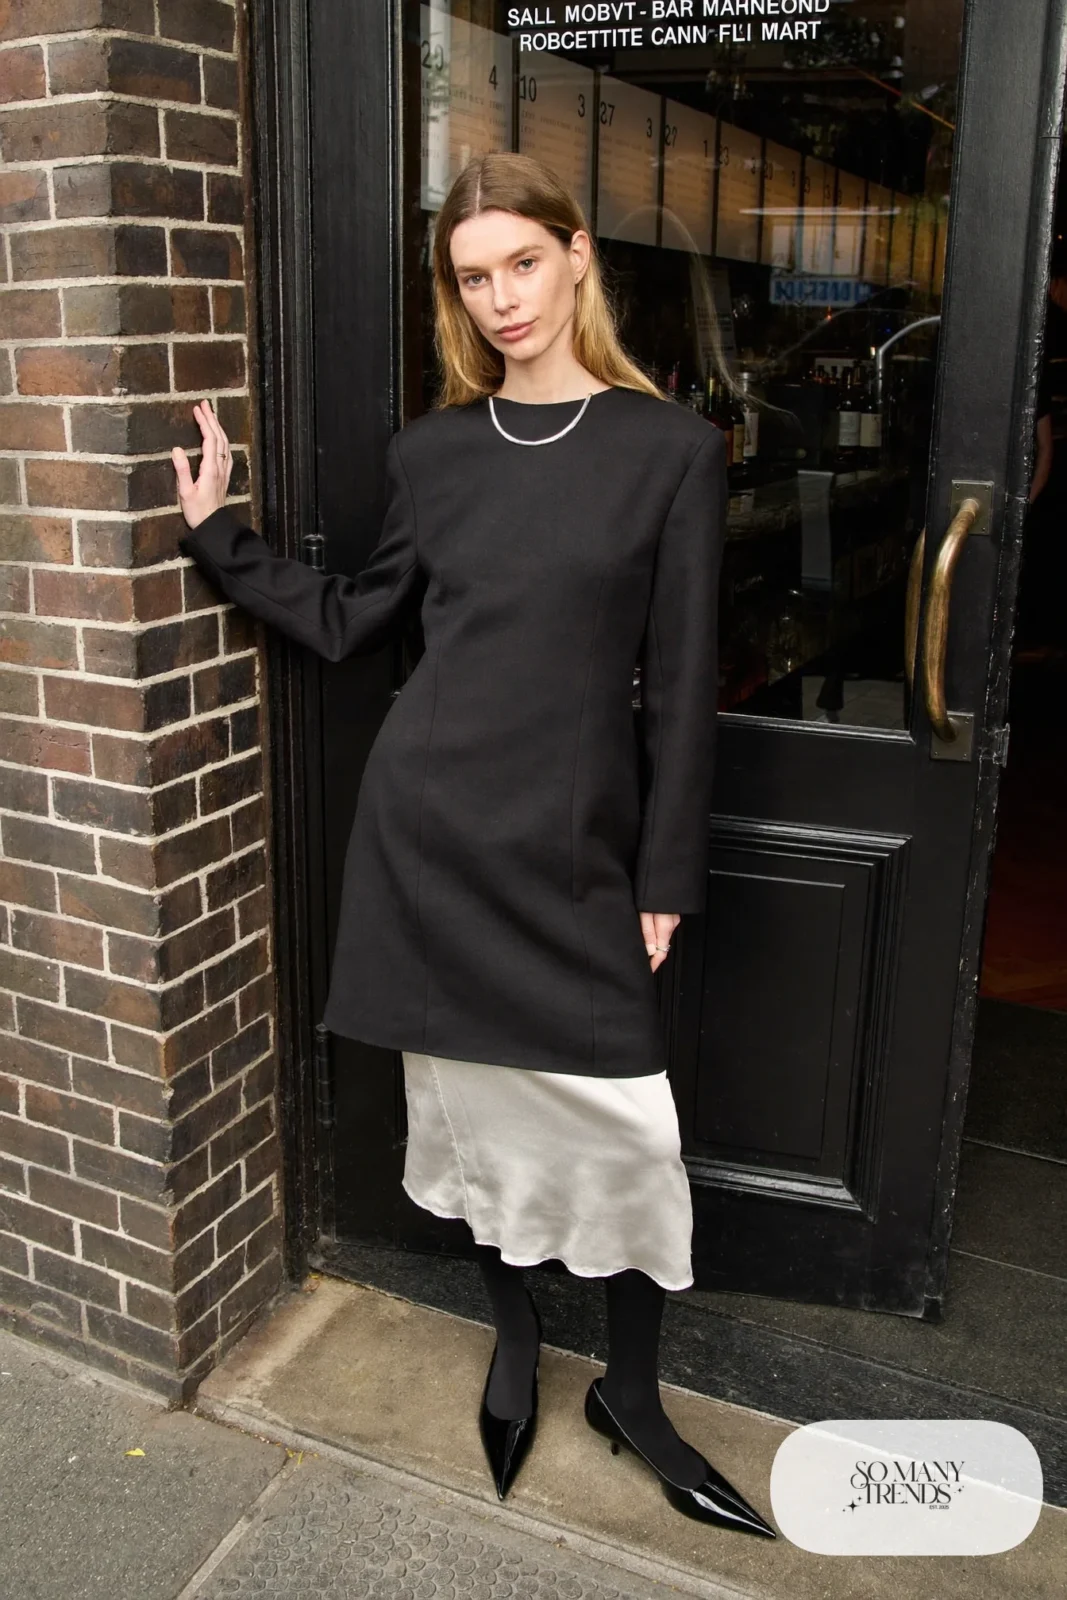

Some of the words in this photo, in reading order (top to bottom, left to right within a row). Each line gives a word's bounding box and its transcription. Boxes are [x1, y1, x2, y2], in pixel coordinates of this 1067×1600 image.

[507, 7, 556, 27] SALL
[652, 0, 694, 19] BAR
[519, 28, 643, 52] ROBCETTITE
[761, 21, 822, 41] MART
[488, 64, 498, 91] 4
[577, 93, 586, 118] 3
[600, 101, 615, 127] 27
[646, 117, 653, 138] 3
